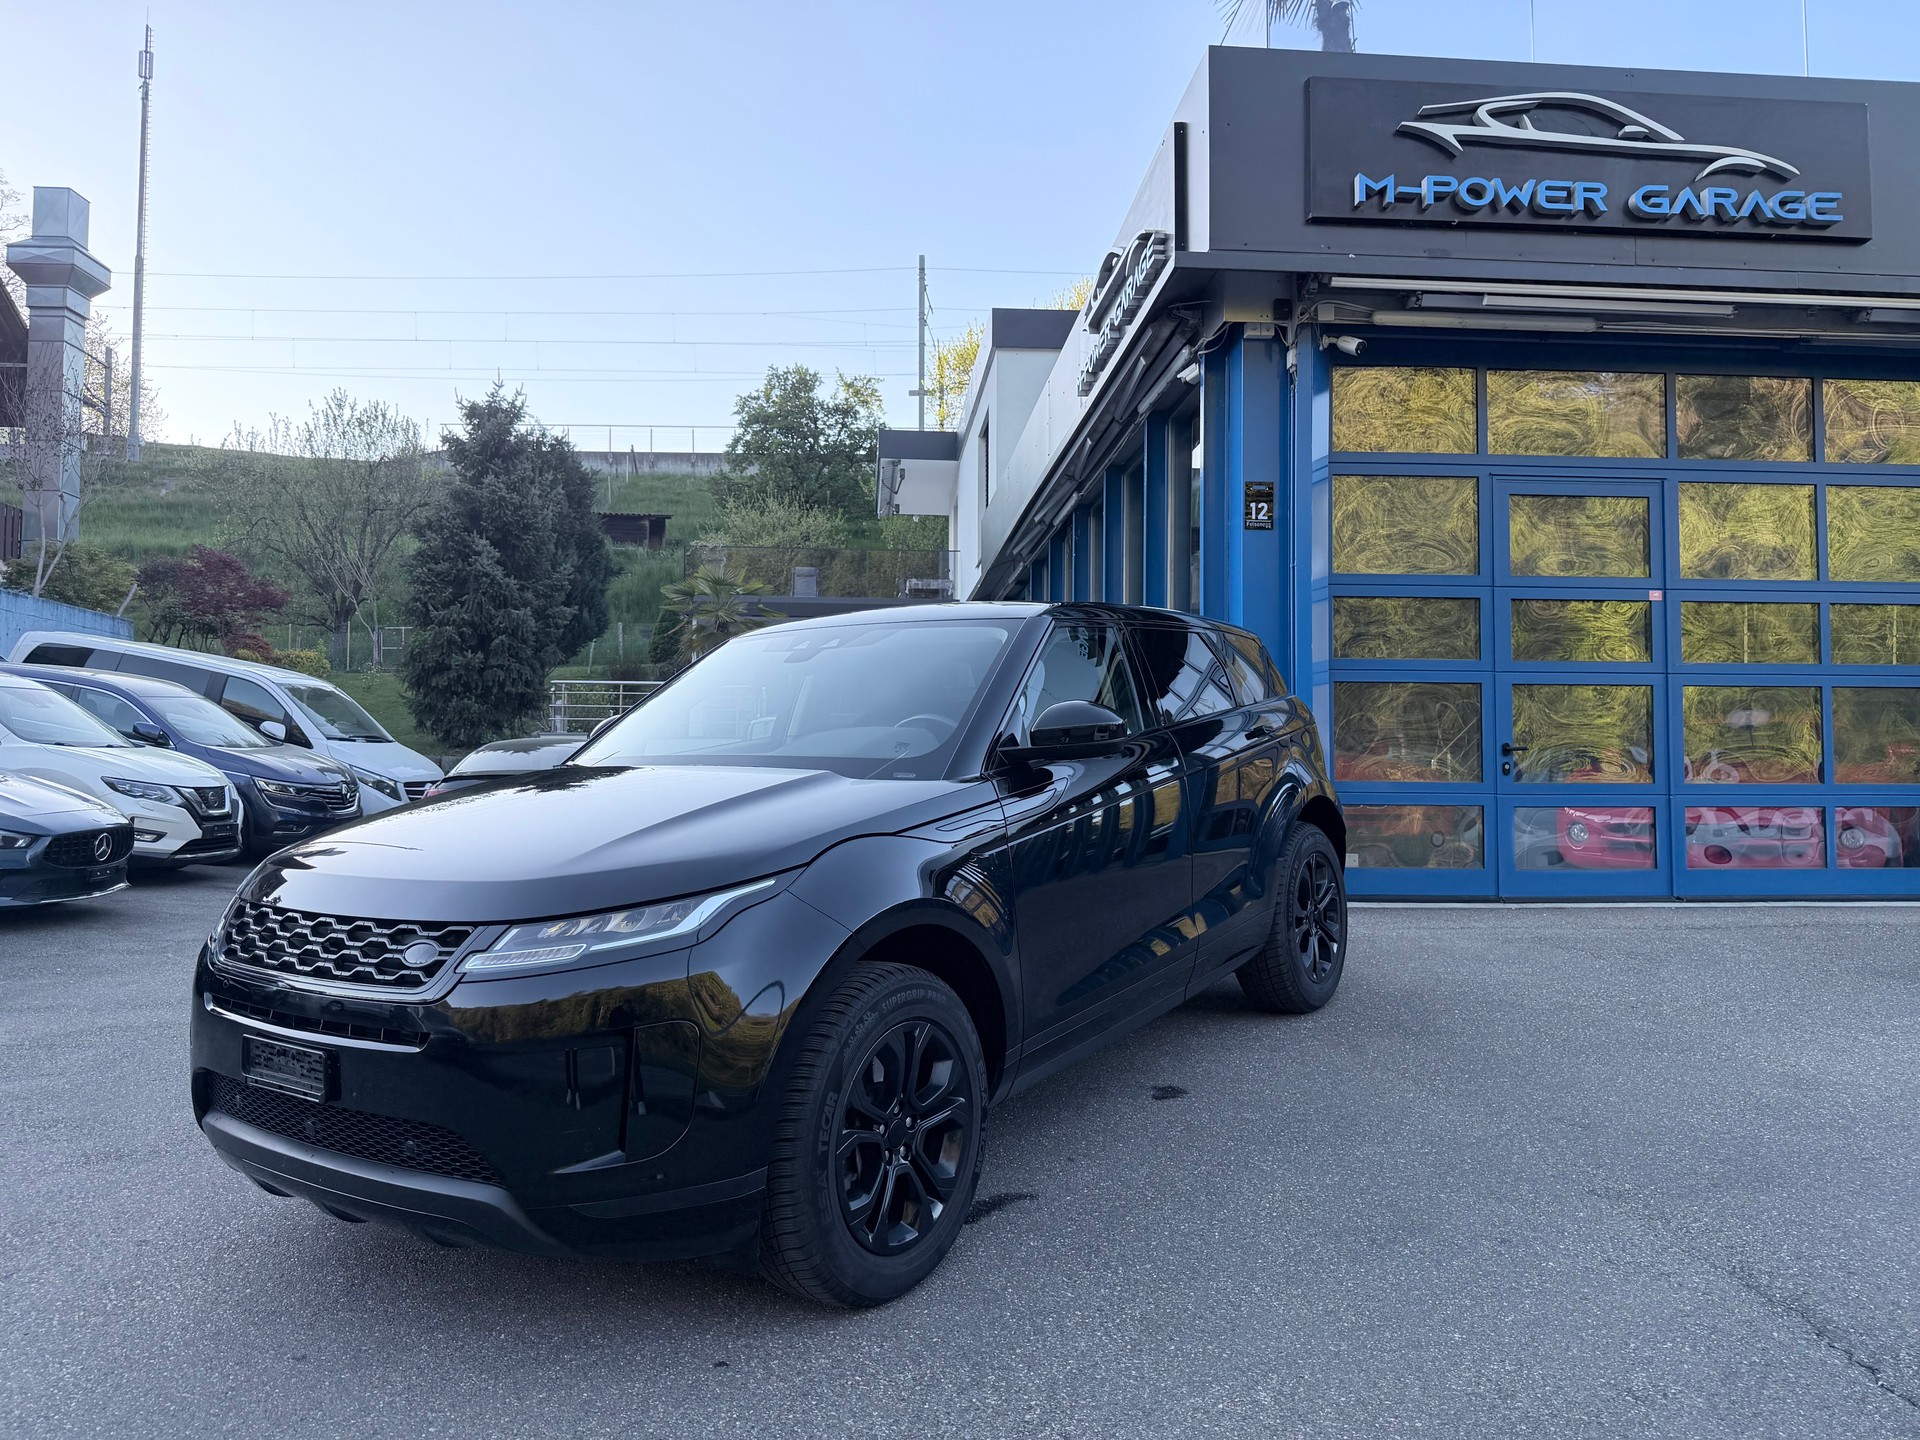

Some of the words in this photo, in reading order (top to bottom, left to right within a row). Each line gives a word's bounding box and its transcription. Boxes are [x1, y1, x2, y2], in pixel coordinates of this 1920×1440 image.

[1354, 172, 1608, 213] M-POWER
[1629, 184, 1844, 224] GARAGE
[1113, 232, 1156, 327] GARAGE
[1249, 502, 1268, 520] 12
[881, 988, 925, 1014] SUPERGRIP
[817, 1090, 838, 1156] TECAR
